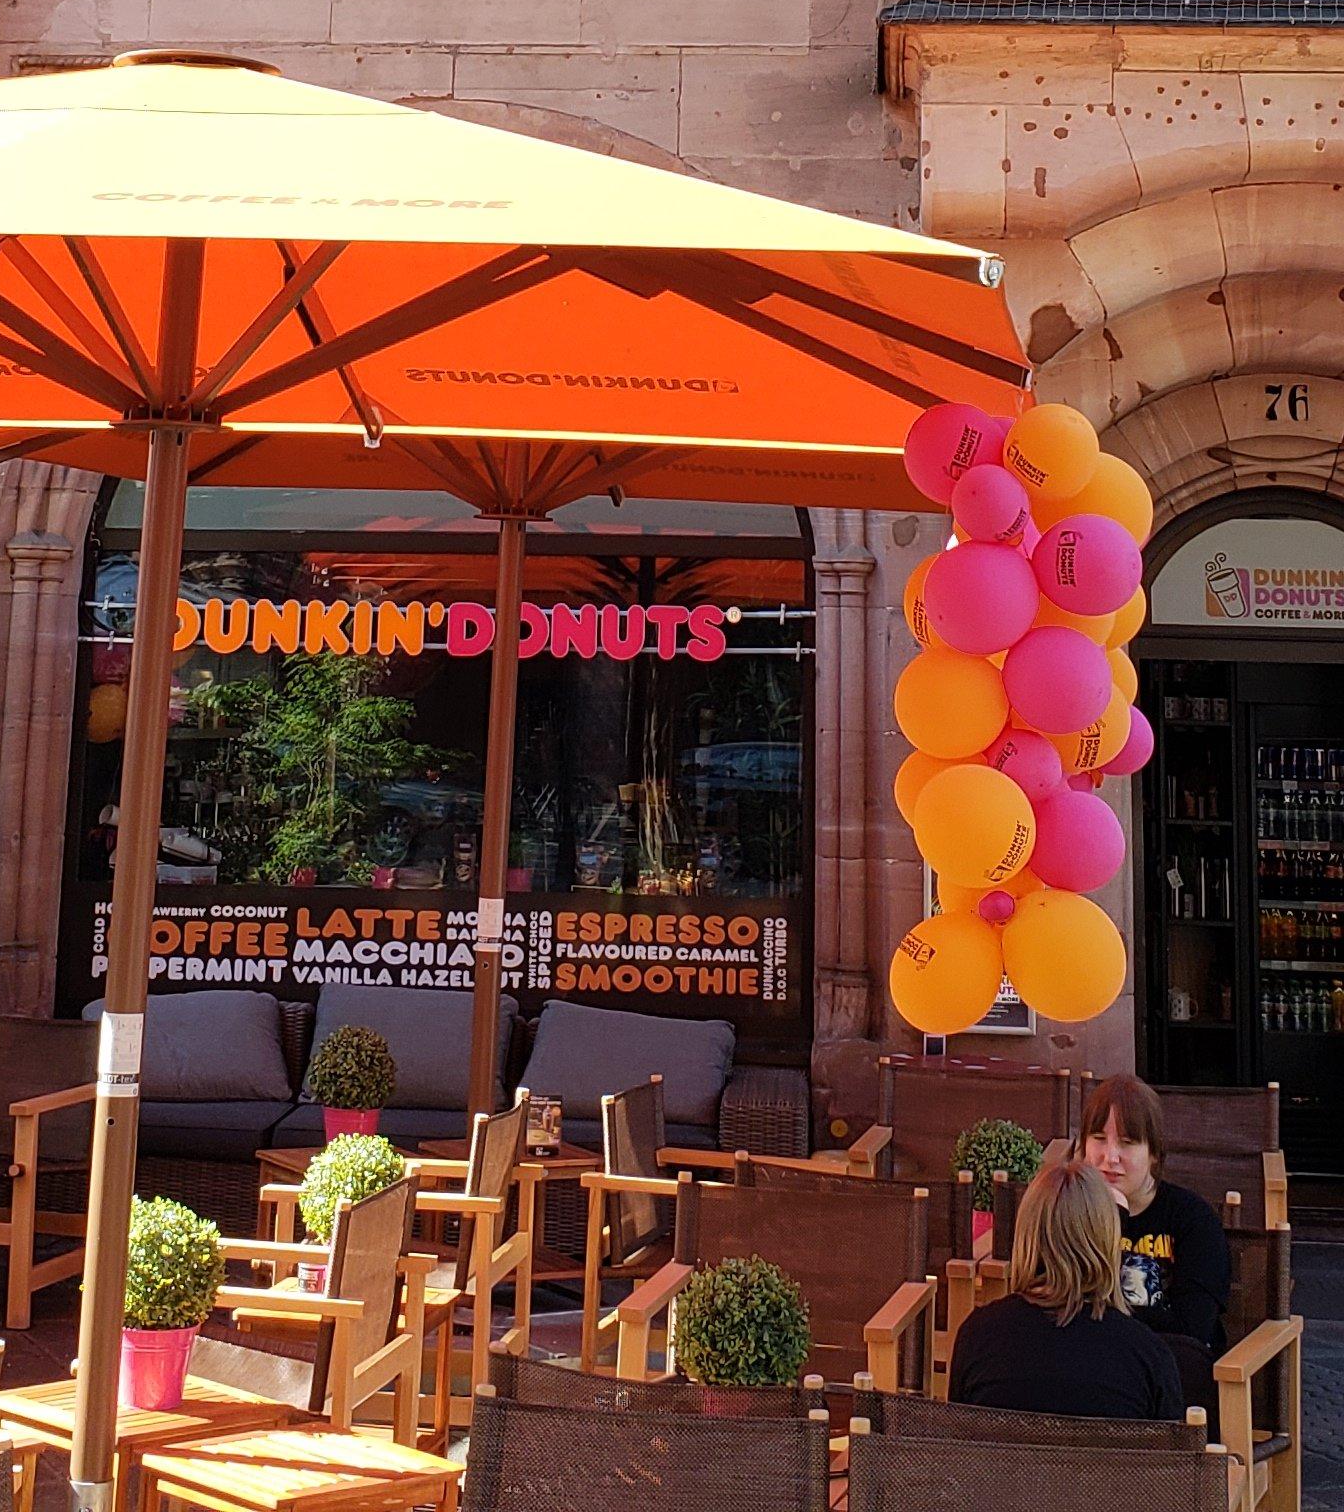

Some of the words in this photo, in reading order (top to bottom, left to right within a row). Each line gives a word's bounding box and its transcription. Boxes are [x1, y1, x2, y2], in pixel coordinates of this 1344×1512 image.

[91, 192, 302, 205] COFFEE
[352, 198, 513, 209] MORE
[1264, 384, 1309, 422] 76
[446, 601, 726, 661] DONUTS
[1255, 609, 1301, 619] COFFEE
[152, 906, 206, 918] AWBERRY
[211, 905, 288, 919] COCONUT
[296, 907, 442, 940] LATTE
[447, 910, 526, 928] MOA
[528, 910, 538, 948] CHOC
[556, 911, 760, 947] ESPRESSO
[93, 918, 105, 953] COLD
[107, 919, 289, 957] OFFEE
[538, 910, 553, 989] SPICED
[776, 917, 788, 964] TURBO
[91, 956, 288, 983] PPERMINT
[292, 939, 525, 968] MACCHIAO
[528, 950, 538, 989] WHITE
[556, 943, 673, 961] FLAVOURED
[675, 947, 760, 963] CARAMEL
[762, 917, 775, 1001] DUNKACCINO
[292, 966, 394, 986] VANILLA
[401, 969, 524, 989] HAZELUT
[556, 963, 759, 996] SMOOTHIE
